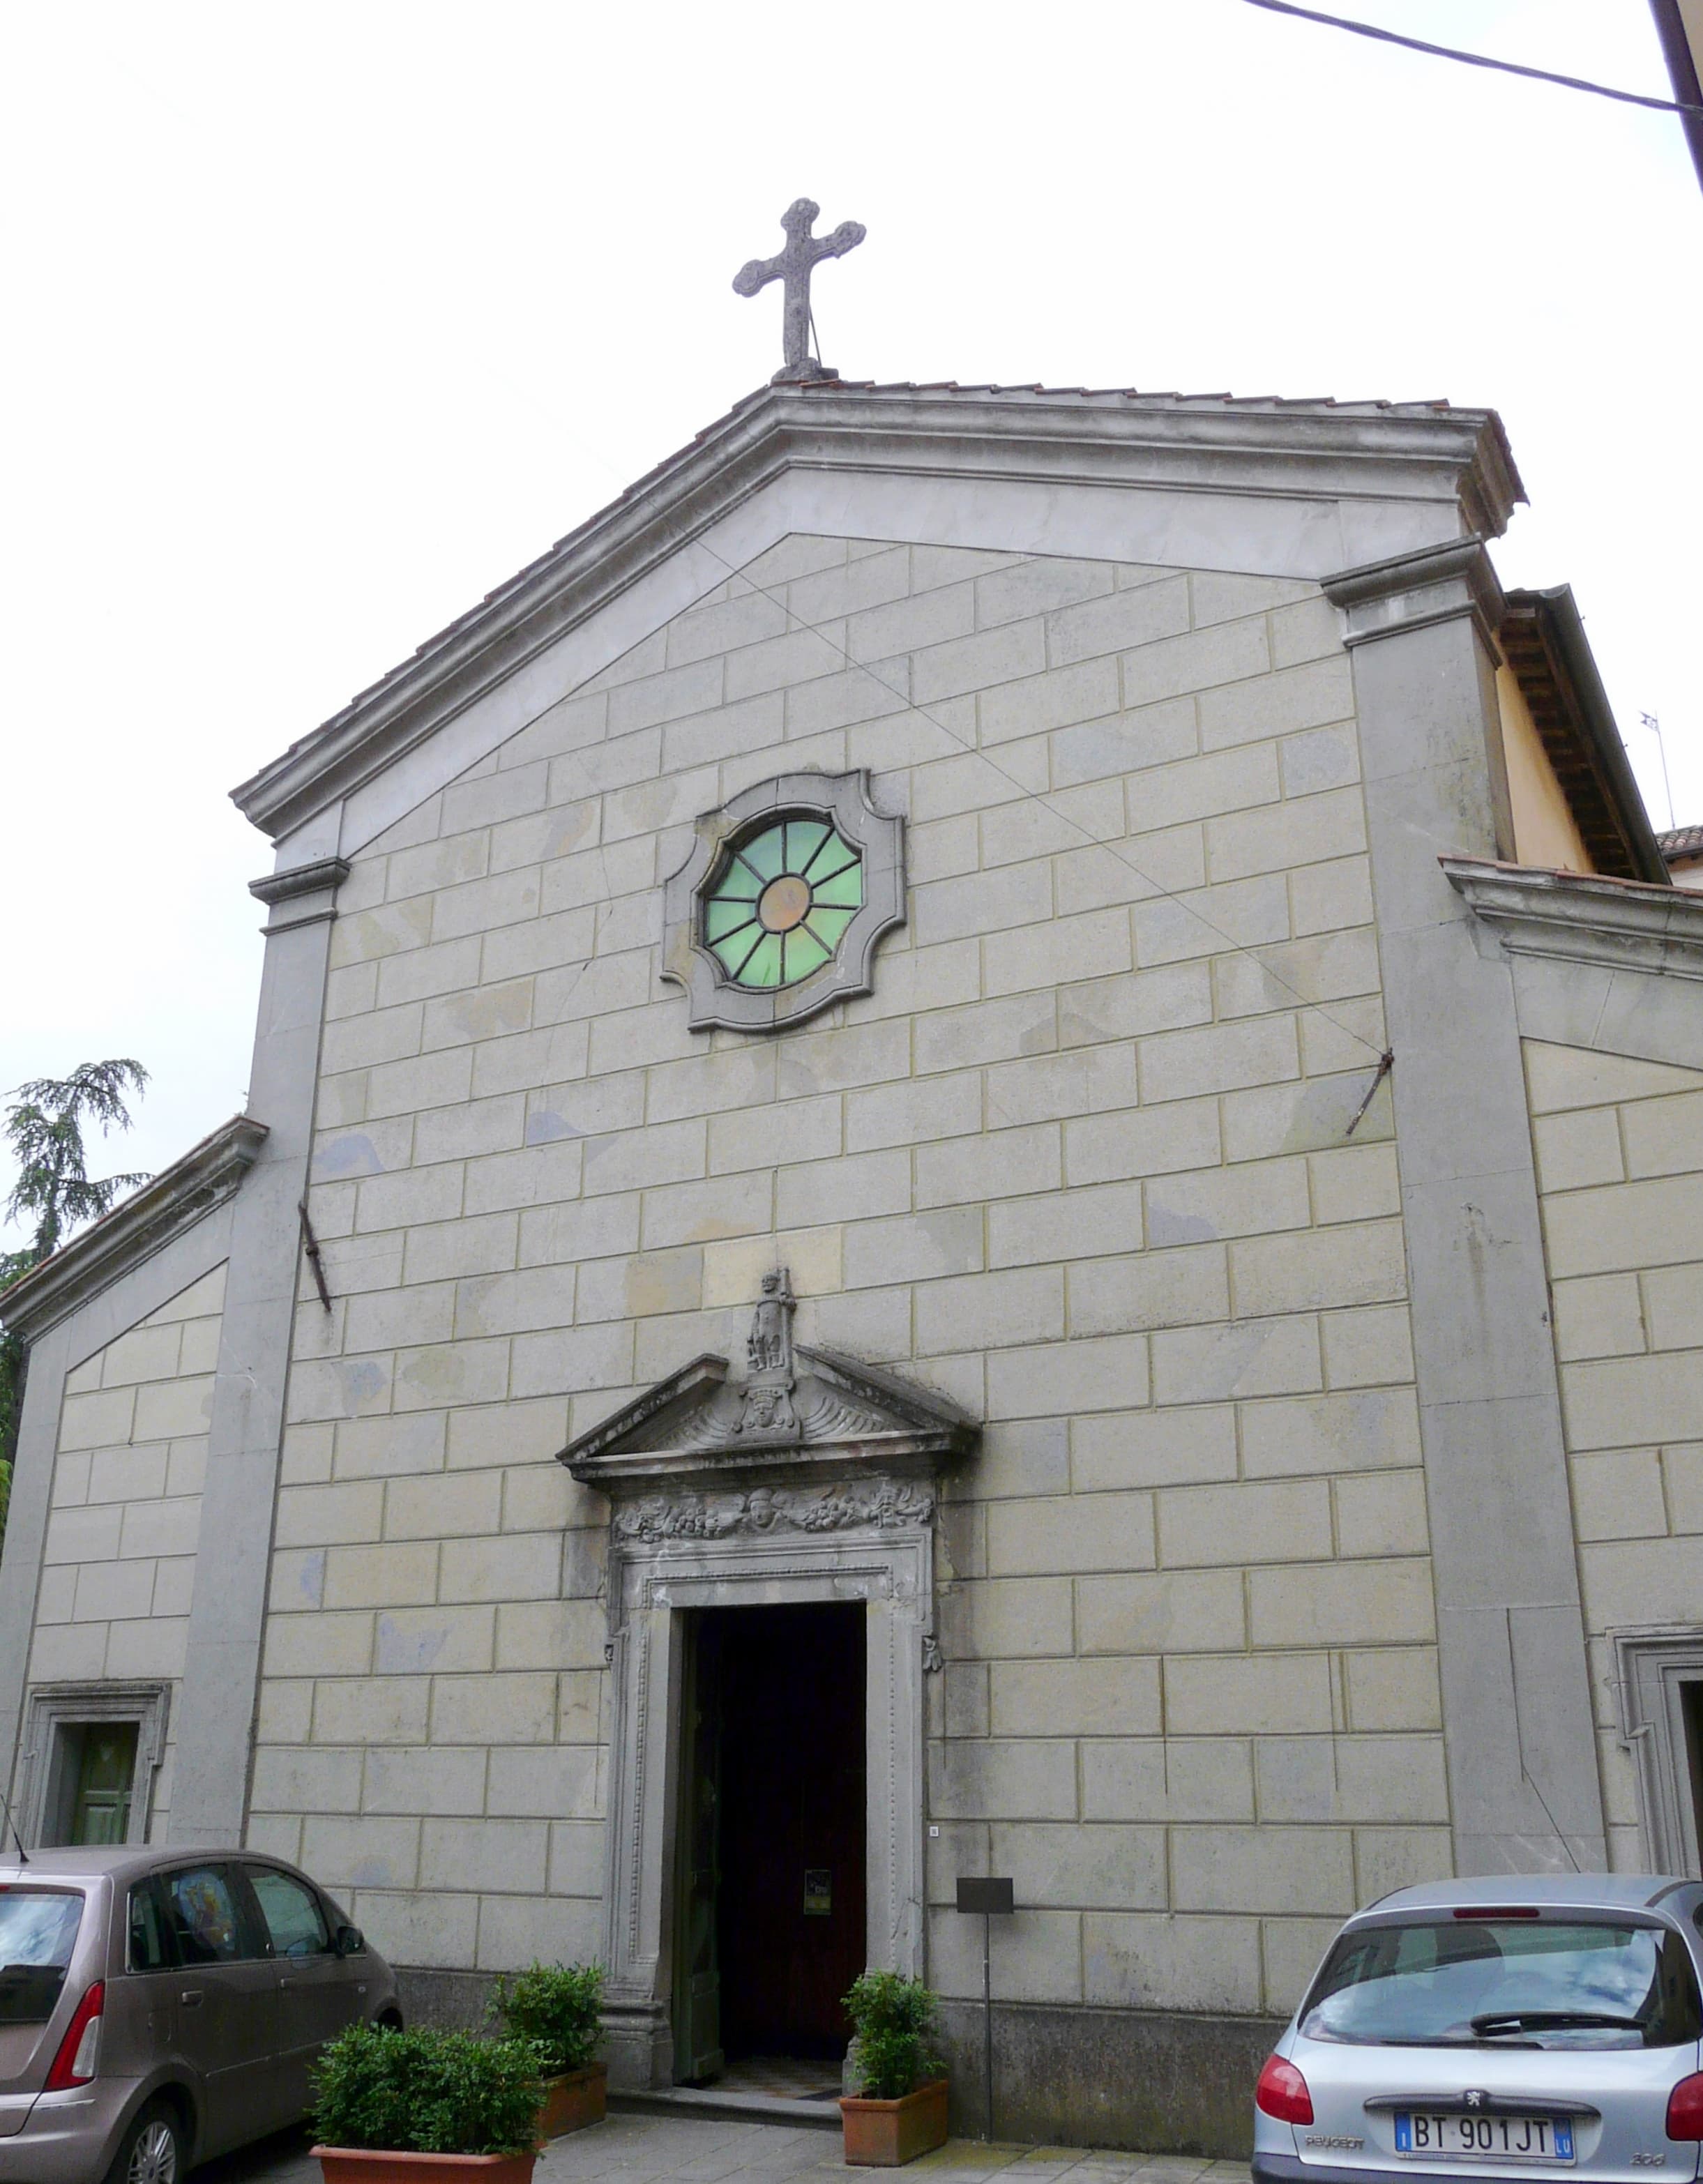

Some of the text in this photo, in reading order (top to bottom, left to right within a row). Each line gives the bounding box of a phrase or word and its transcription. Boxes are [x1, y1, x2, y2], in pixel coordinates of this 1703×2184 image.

[1305, 2135, 1365, 2149] PEUGEOT
[1414, 2116, 1549, 2153] BT 901JT
[1555, 2139, 1570, 2154] LU
[1629, 2152, 1665, 2167] 206
